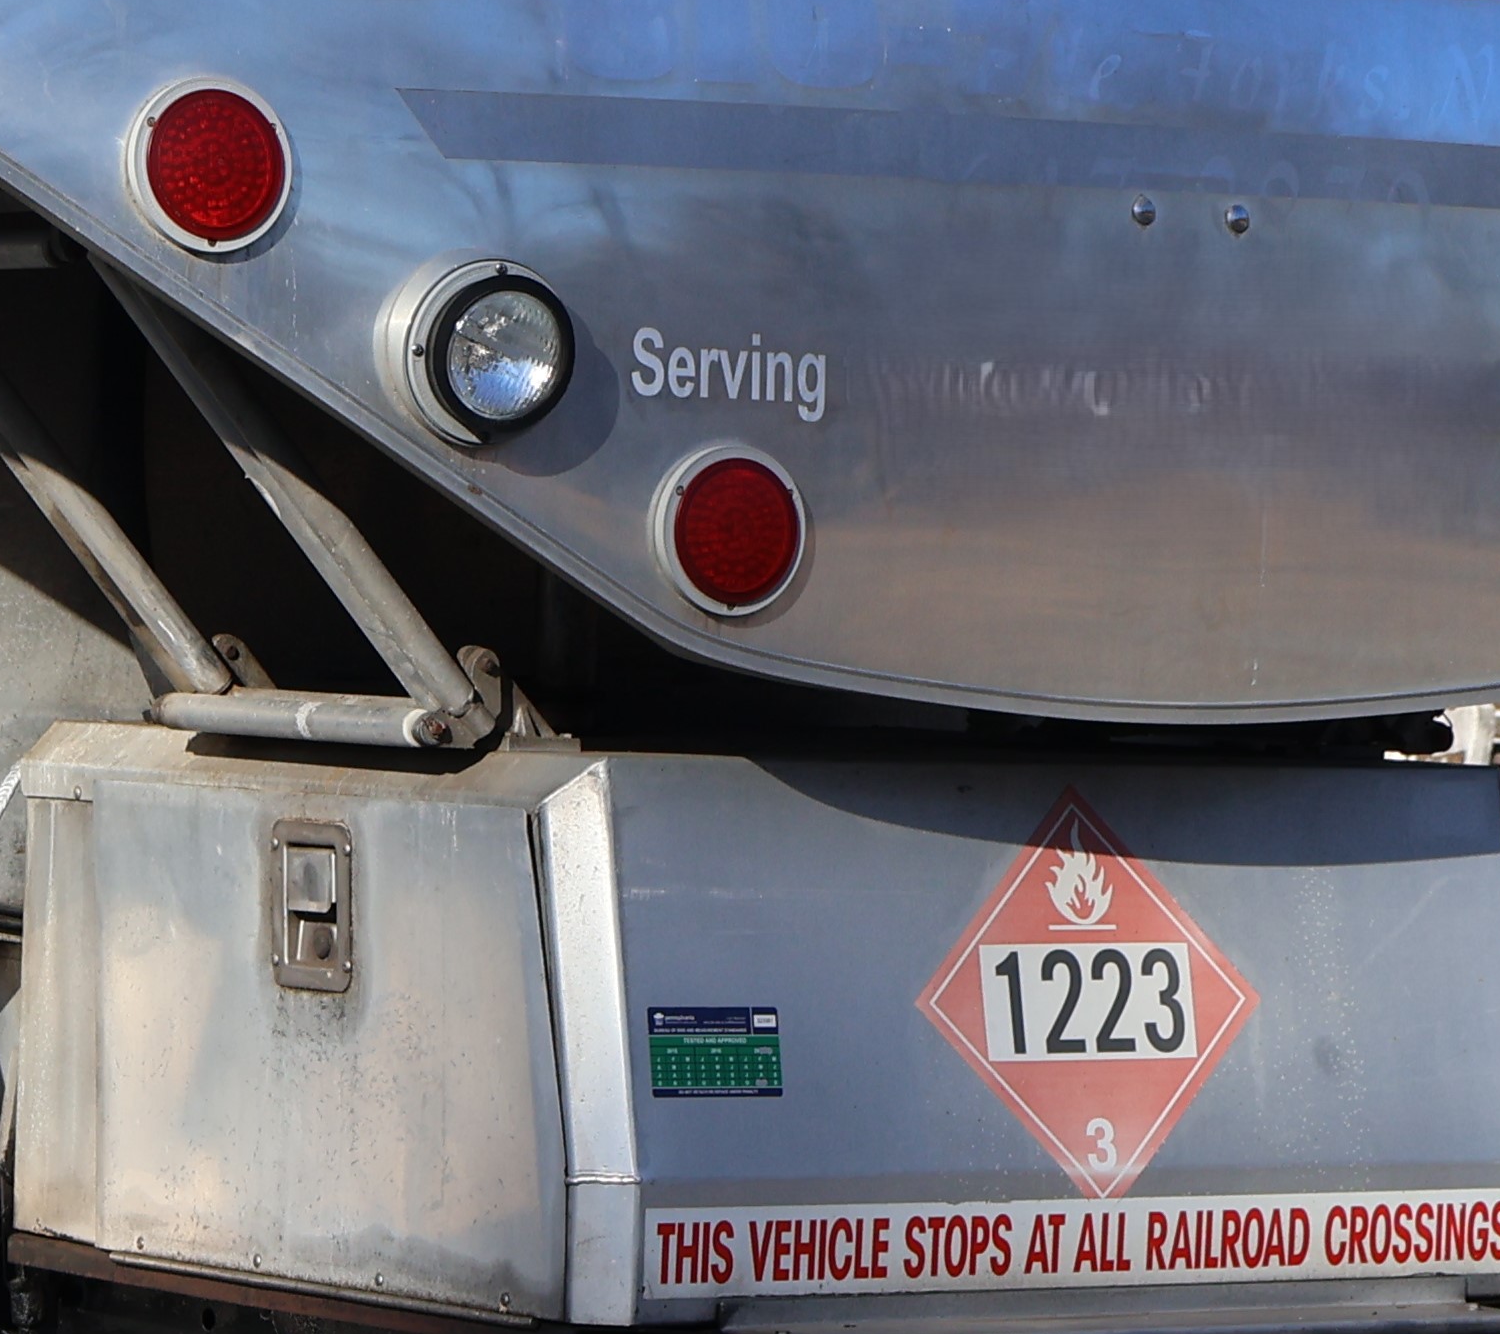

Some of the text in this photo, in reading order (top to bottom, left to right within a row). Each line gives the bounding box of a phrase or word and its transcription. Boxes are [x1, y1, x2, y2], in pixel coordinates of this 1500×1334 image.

[631, 327, 826, 422] Serving
[995, 948, 1185, 1054] 1223
[1085, 1117, 1118, 1174] 3
[658, 1222, 733, 1283] THIS
[751, 1218, 889, 1280] VEHICLE
[904, 1214, 1013, 1278] STOPS
[1025, 1214, 1066, 1273] AT
[1075, 1213, 1131, 1272] ALL
[1147, 1208, 1310, 1270] RAILROAD
